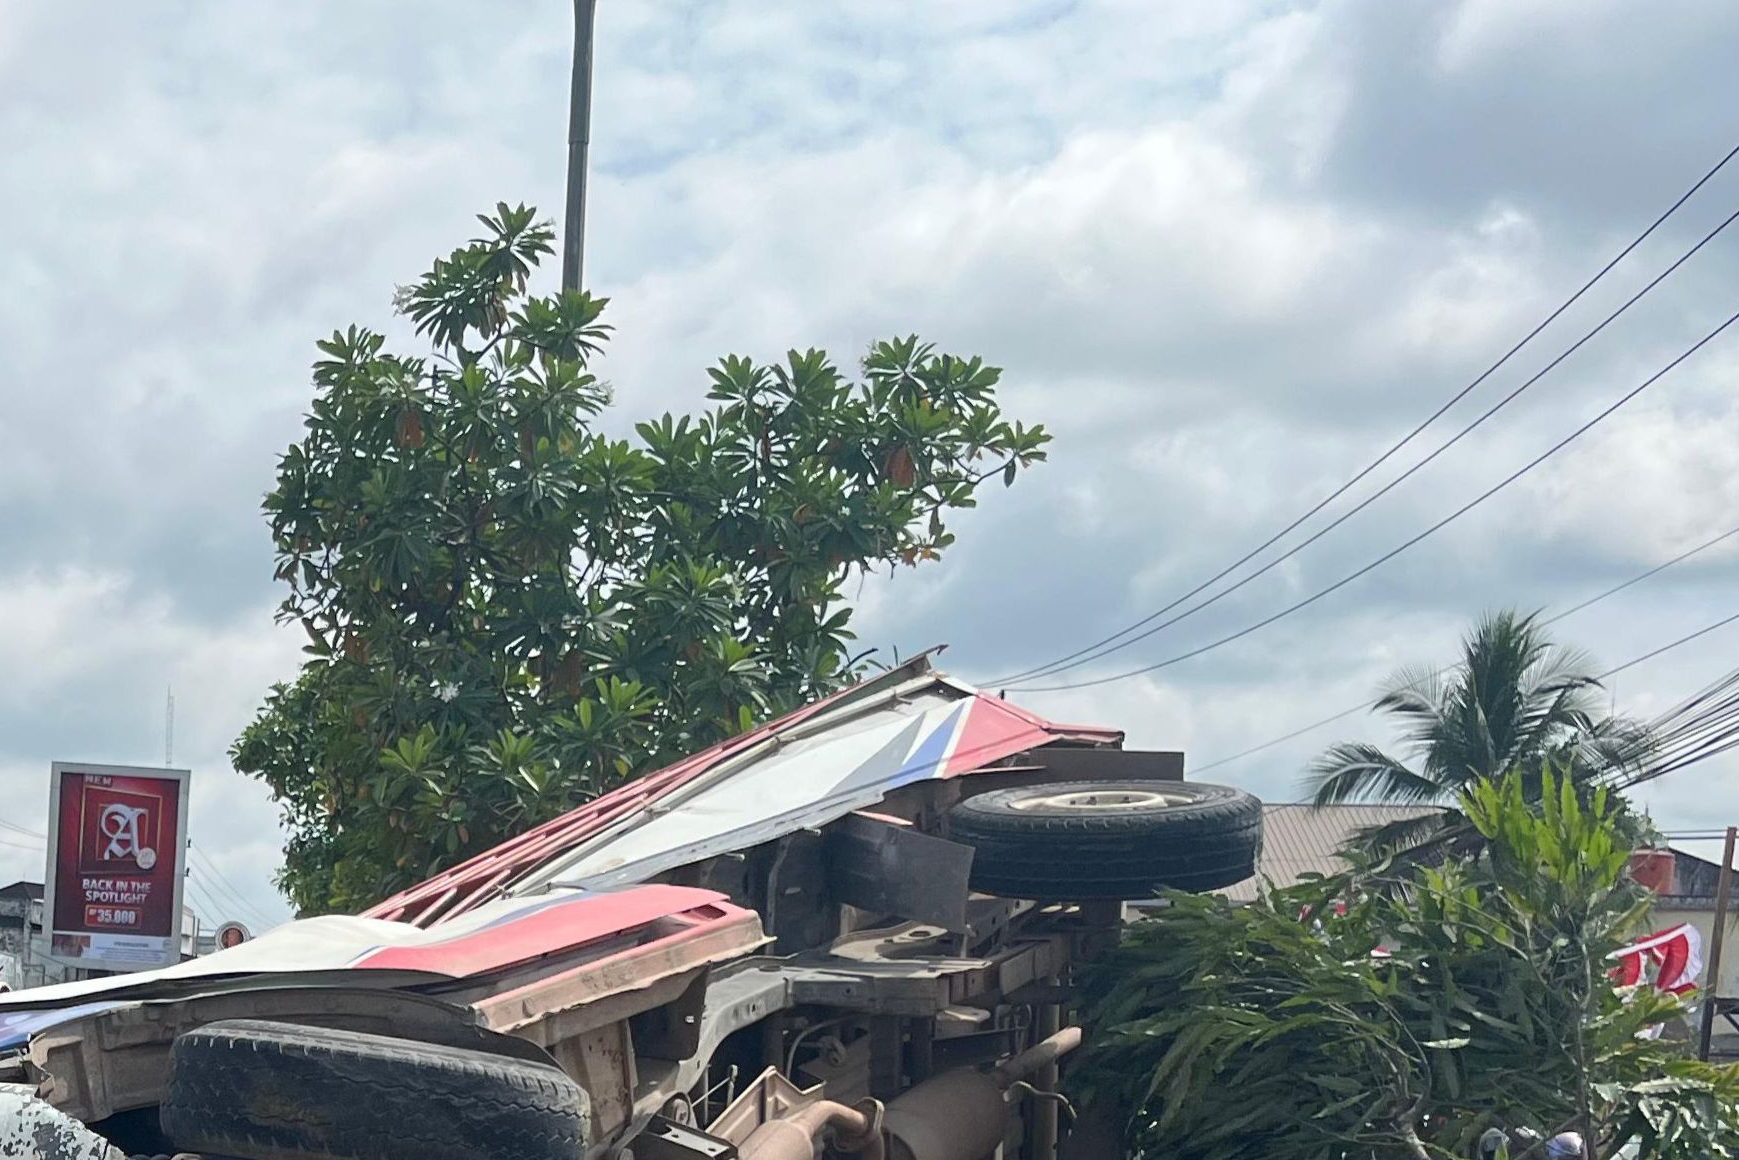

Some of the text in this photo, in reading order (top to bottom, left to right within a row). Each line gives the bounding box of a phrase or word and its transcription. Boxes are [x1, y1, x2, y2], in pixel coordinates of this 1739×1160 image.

[85, 776, 111, 786] NEW
[82, 878, 152, 893] BACK IN THE
[84, 890, 148, 905] SPOTLIGHT
